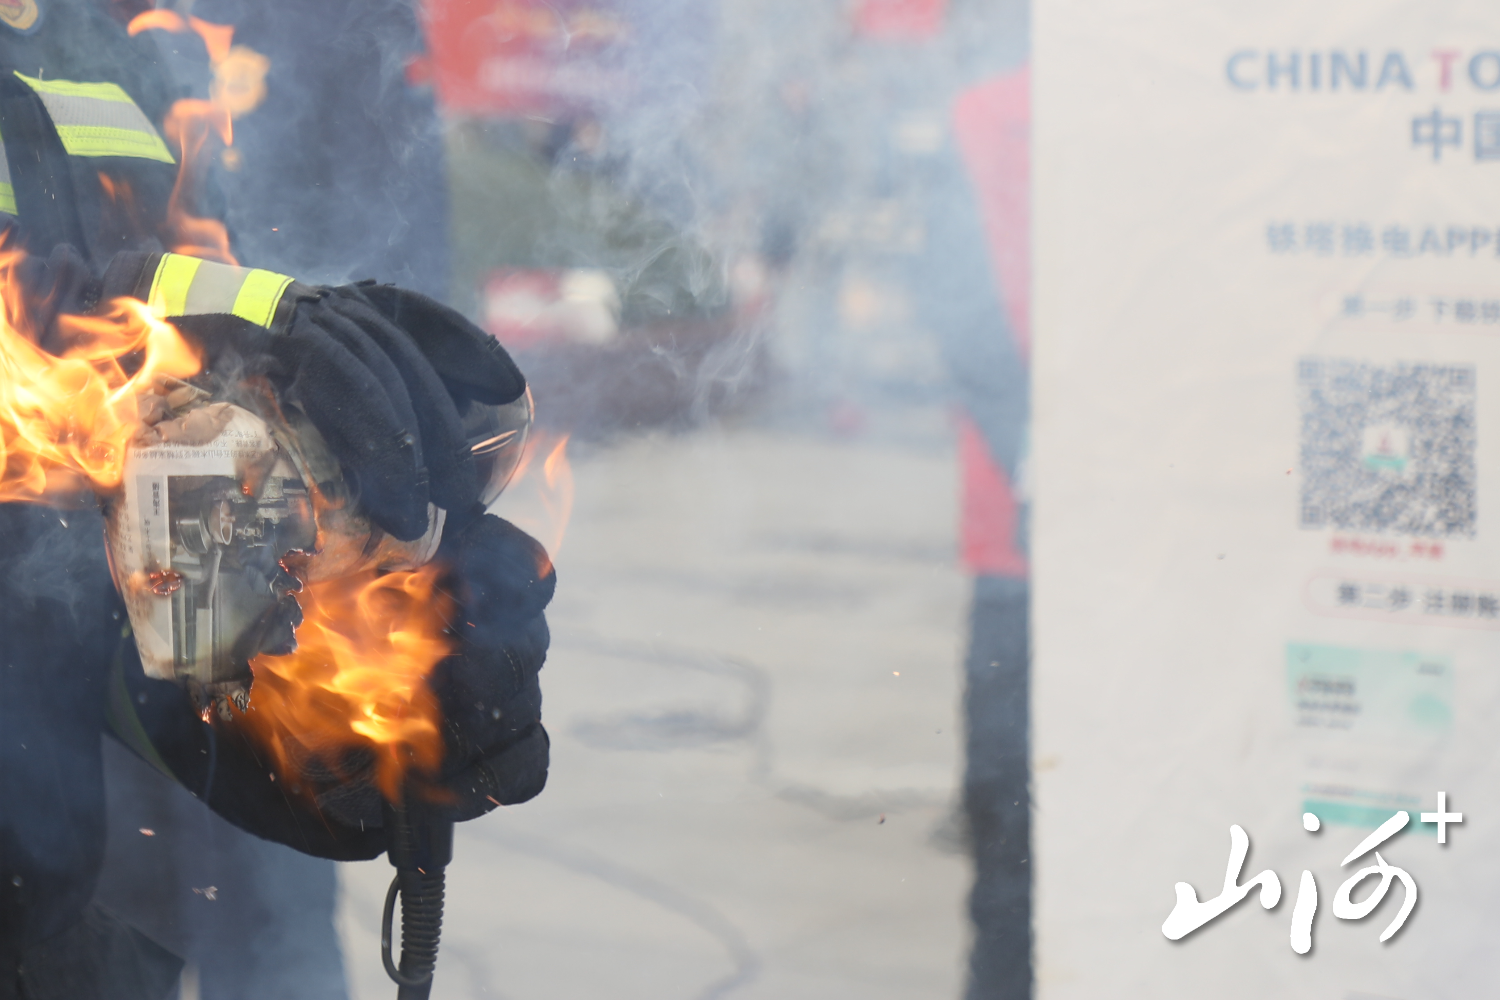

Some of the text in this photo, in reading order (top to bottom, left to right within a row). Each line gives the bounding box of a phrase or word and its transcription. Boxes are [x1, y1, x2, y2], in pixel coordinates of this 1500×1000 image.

[1224, 48, 1417, 94] CHINA
[1266, 219, 1500, 258] 铁塔换电APP
